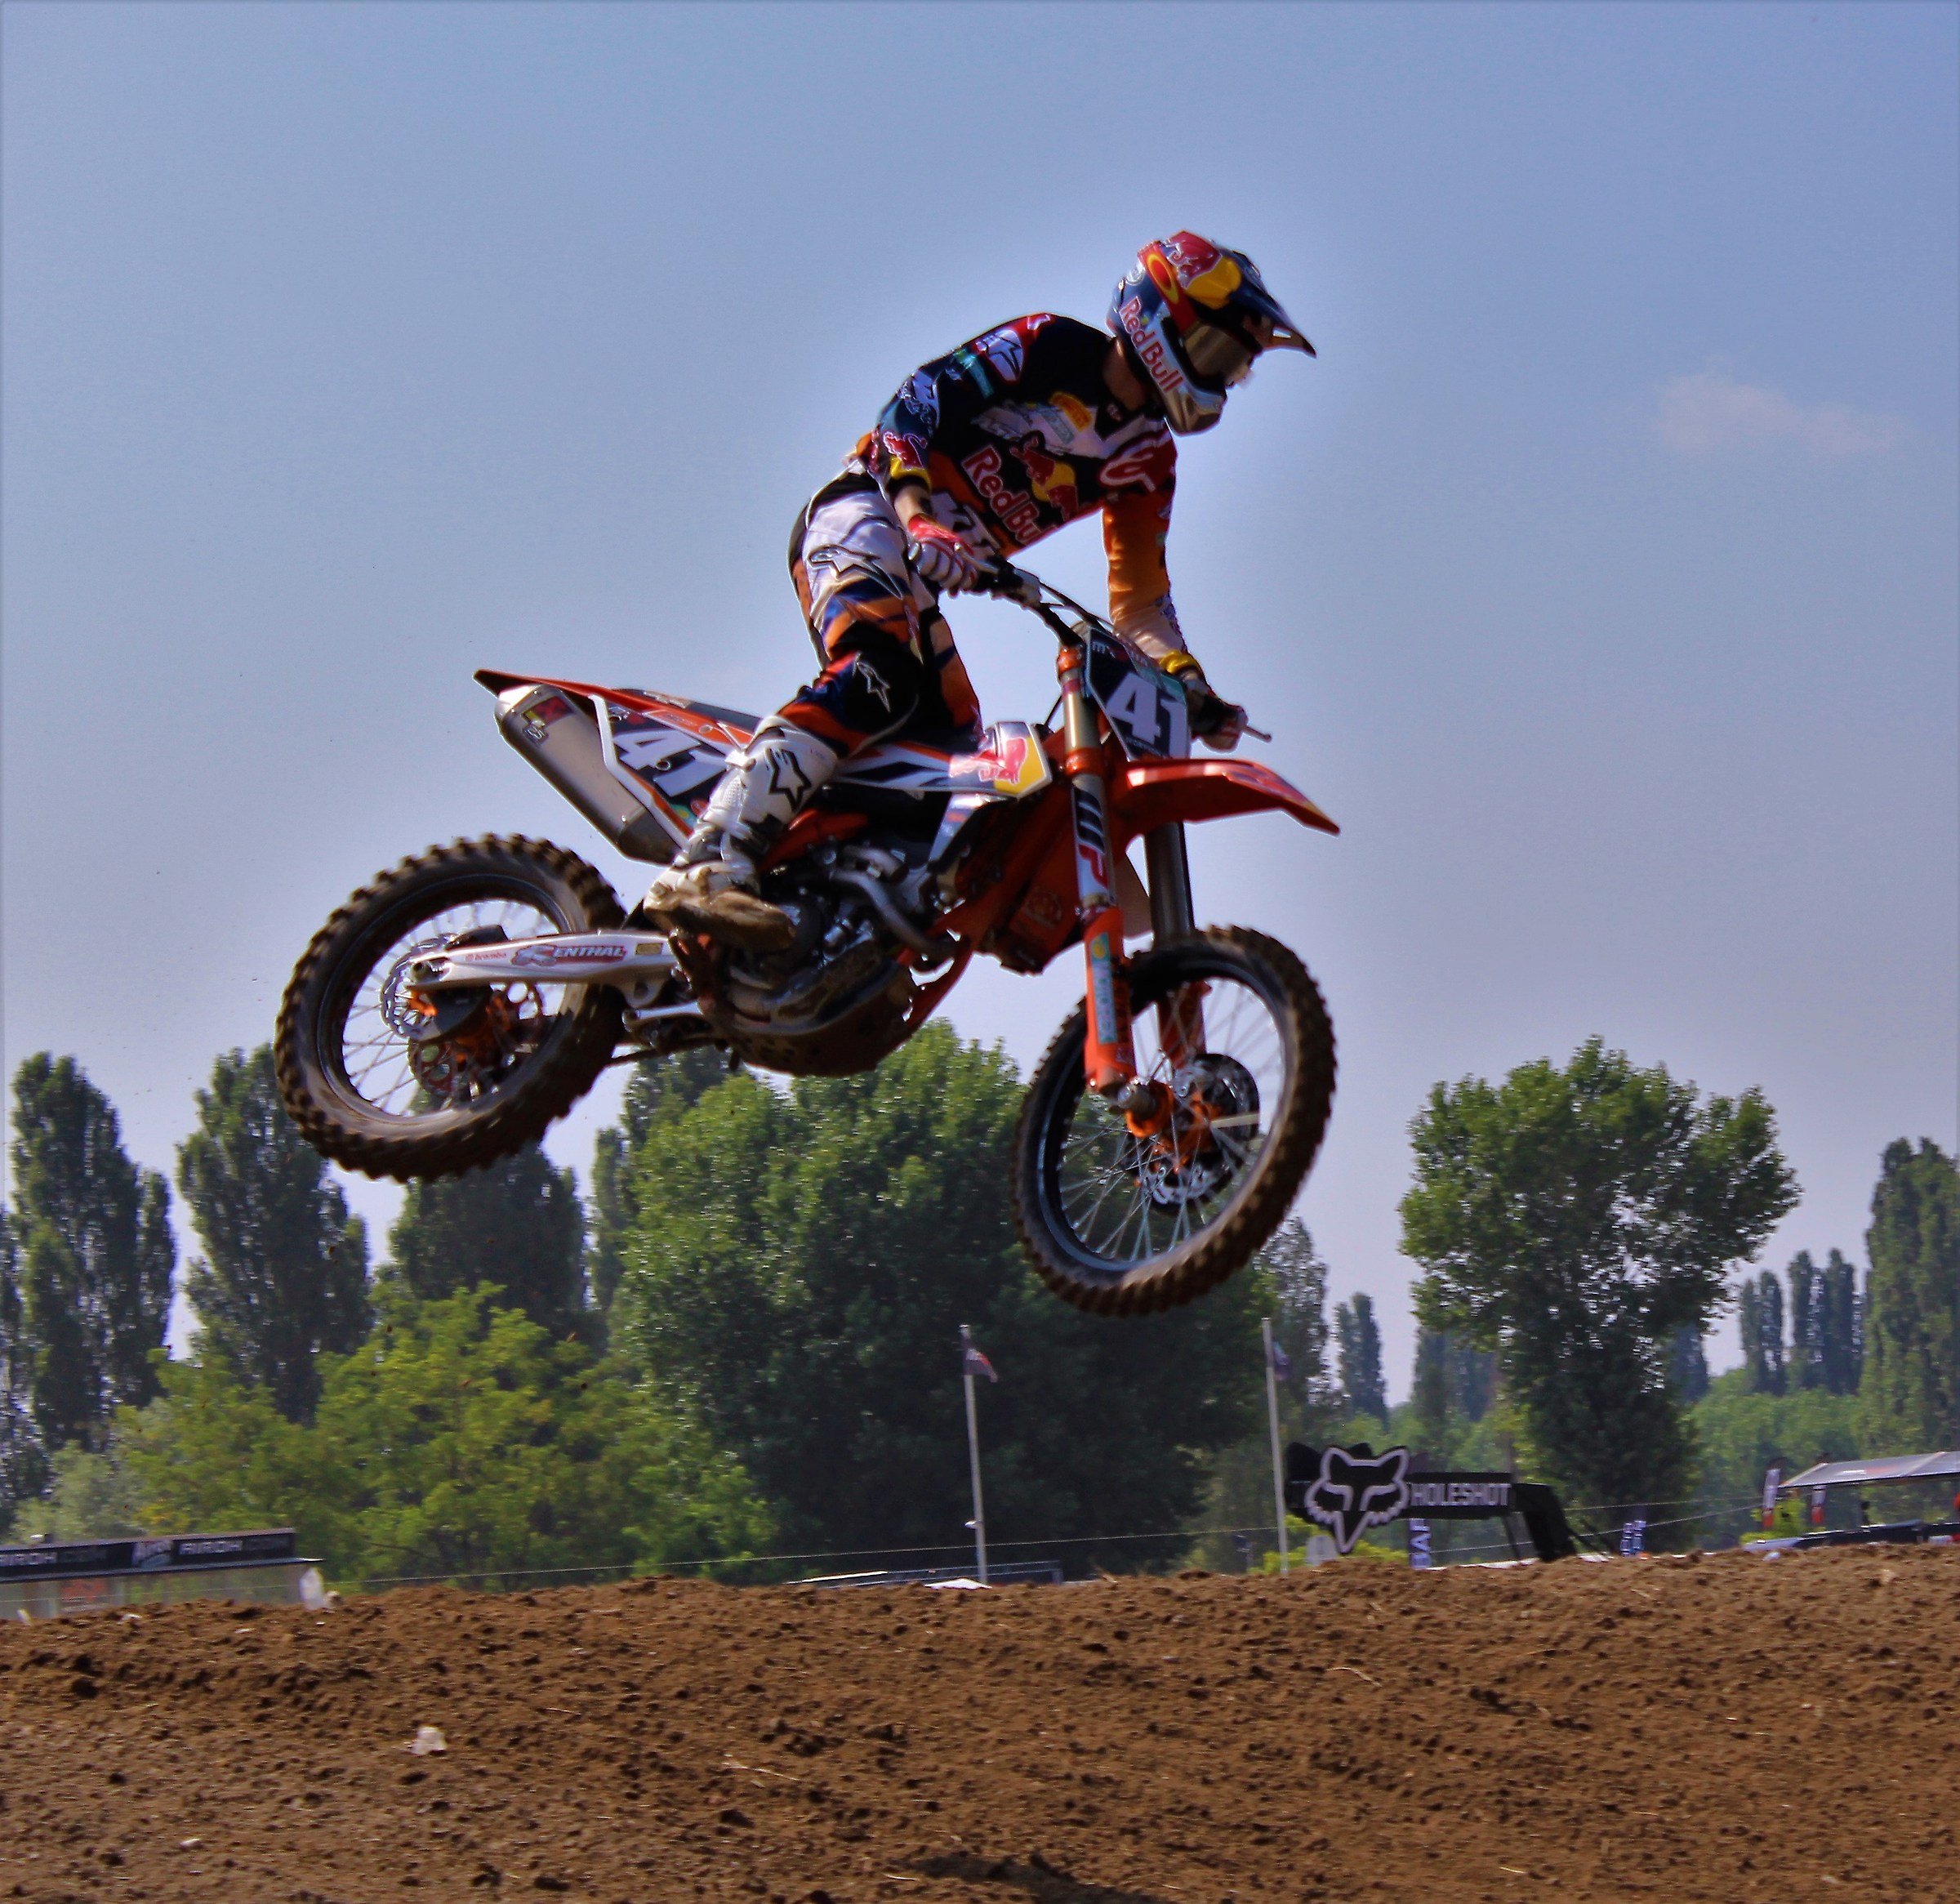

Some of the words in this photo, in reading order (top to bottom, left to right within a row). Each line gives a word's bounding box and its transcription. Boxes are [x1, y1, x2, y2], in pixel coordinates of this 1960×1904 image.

[1119, 295, 1157, 348] Red
[1139, 338, 1184, 394] Bull
[960, 444, 1031, 519] Red
[1106, 671, 1192, 760] 41
[612, 728, 728, 798] 41
[1410, 1483, 1512, 1506] HOLESHOT
